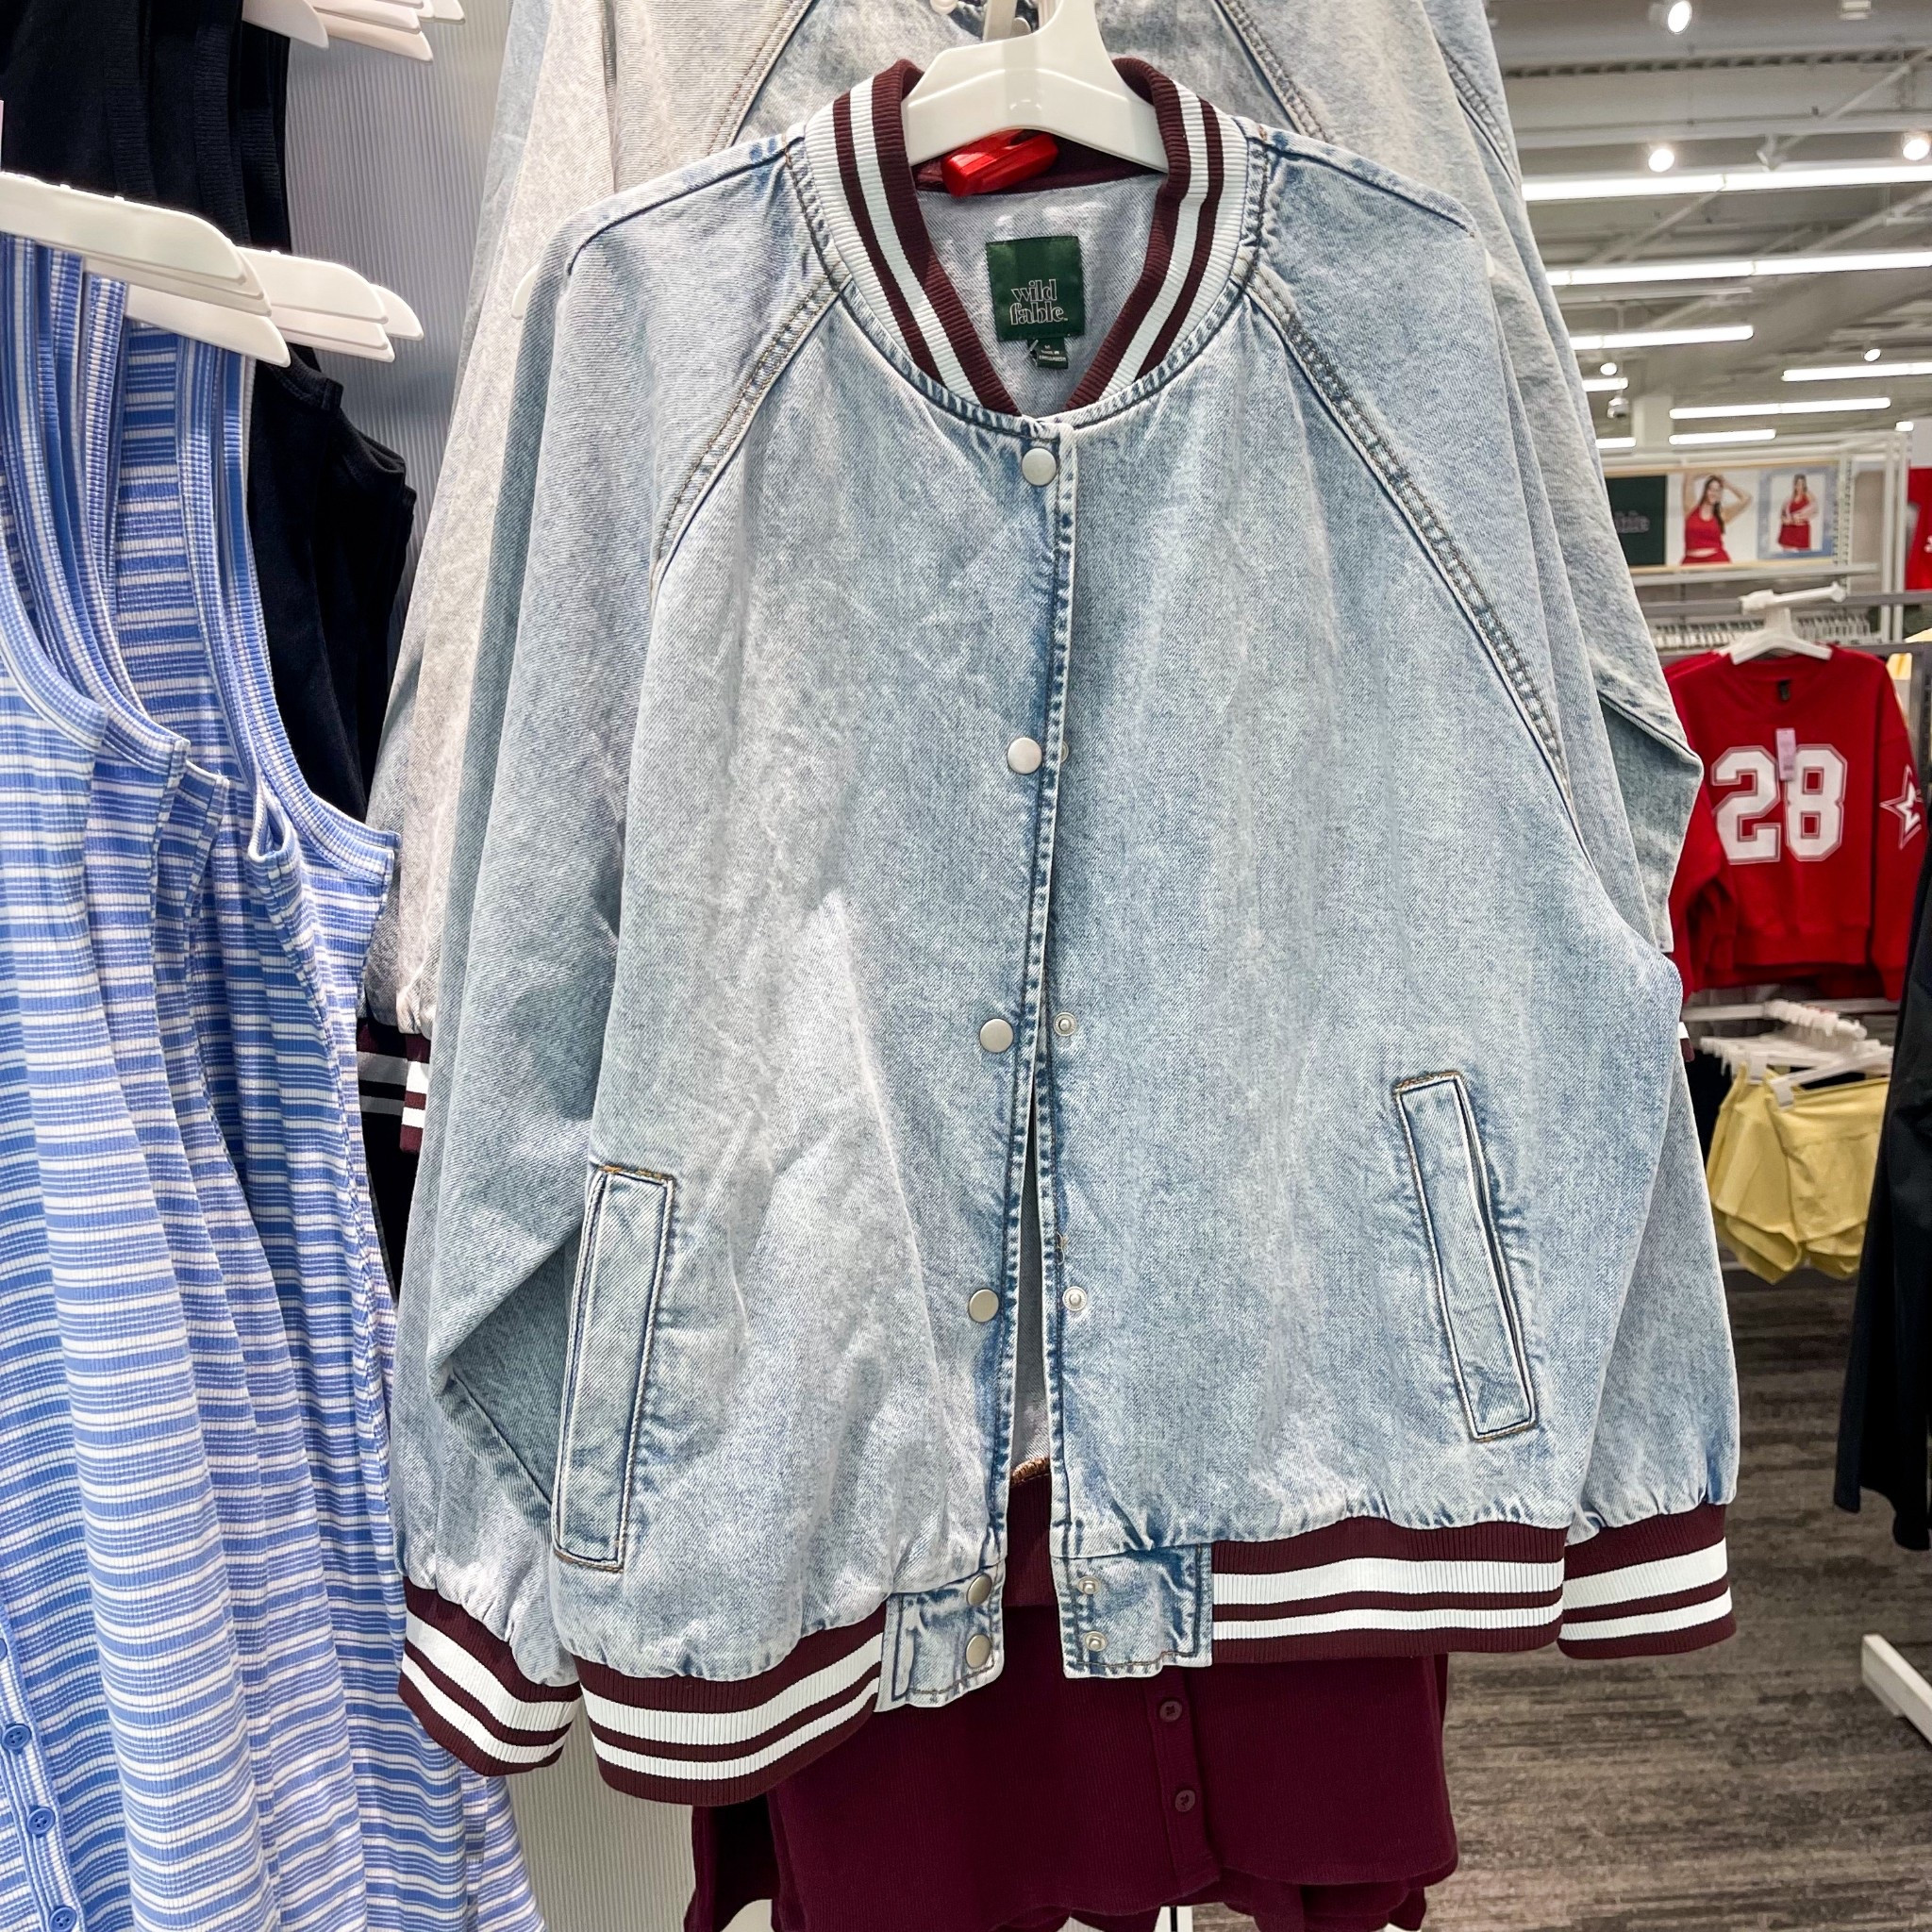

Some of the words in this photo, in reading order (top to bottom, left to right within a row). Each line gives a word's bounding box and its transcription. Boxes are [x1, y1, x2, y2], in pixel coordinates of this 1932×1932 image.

[1011, 279, 1058, 302] wild
[1009, 301, 1064, 325] fable
[1711, 744, 1847, 865] 28
